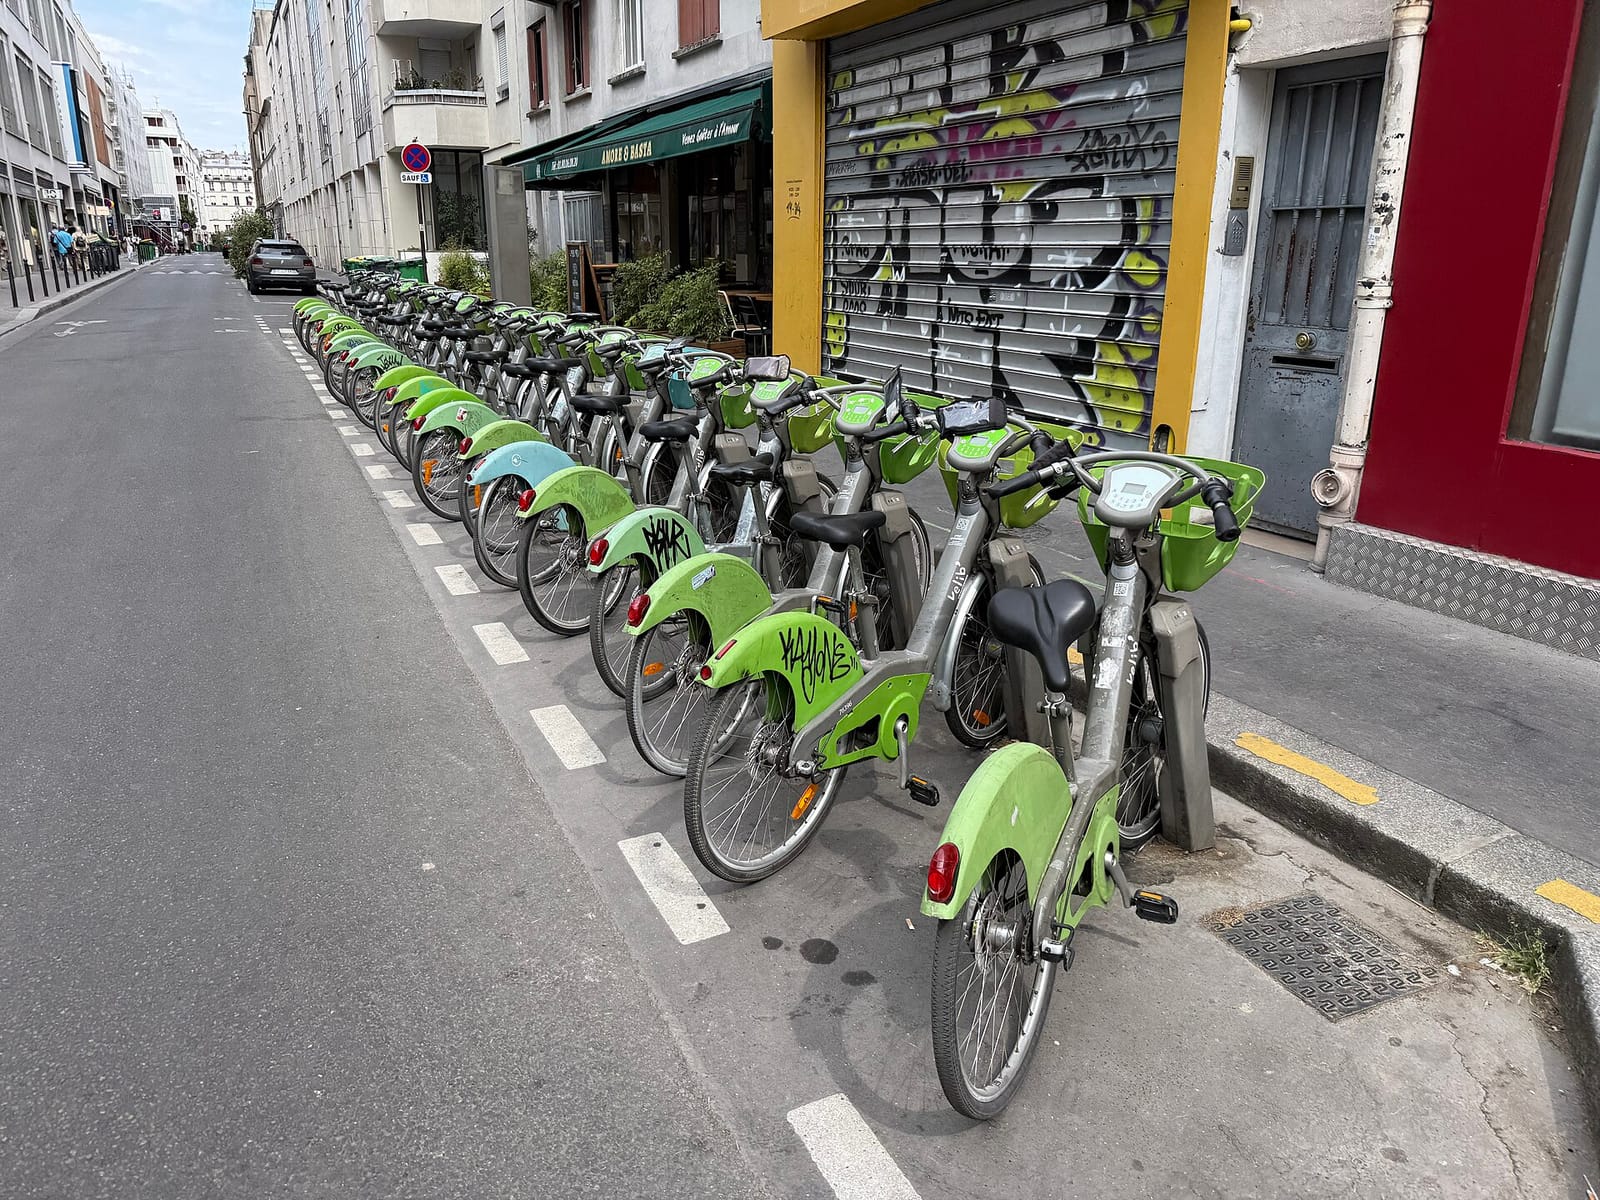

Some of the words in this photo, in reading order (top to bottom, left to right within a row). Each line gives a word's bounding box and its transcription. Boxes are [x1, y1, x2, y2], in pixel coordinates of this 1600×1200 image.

[601, 149, 623, 165] AMORE
[630, 140, 652, 160] BASTA
[401, 174, 420, 182] SAUF
